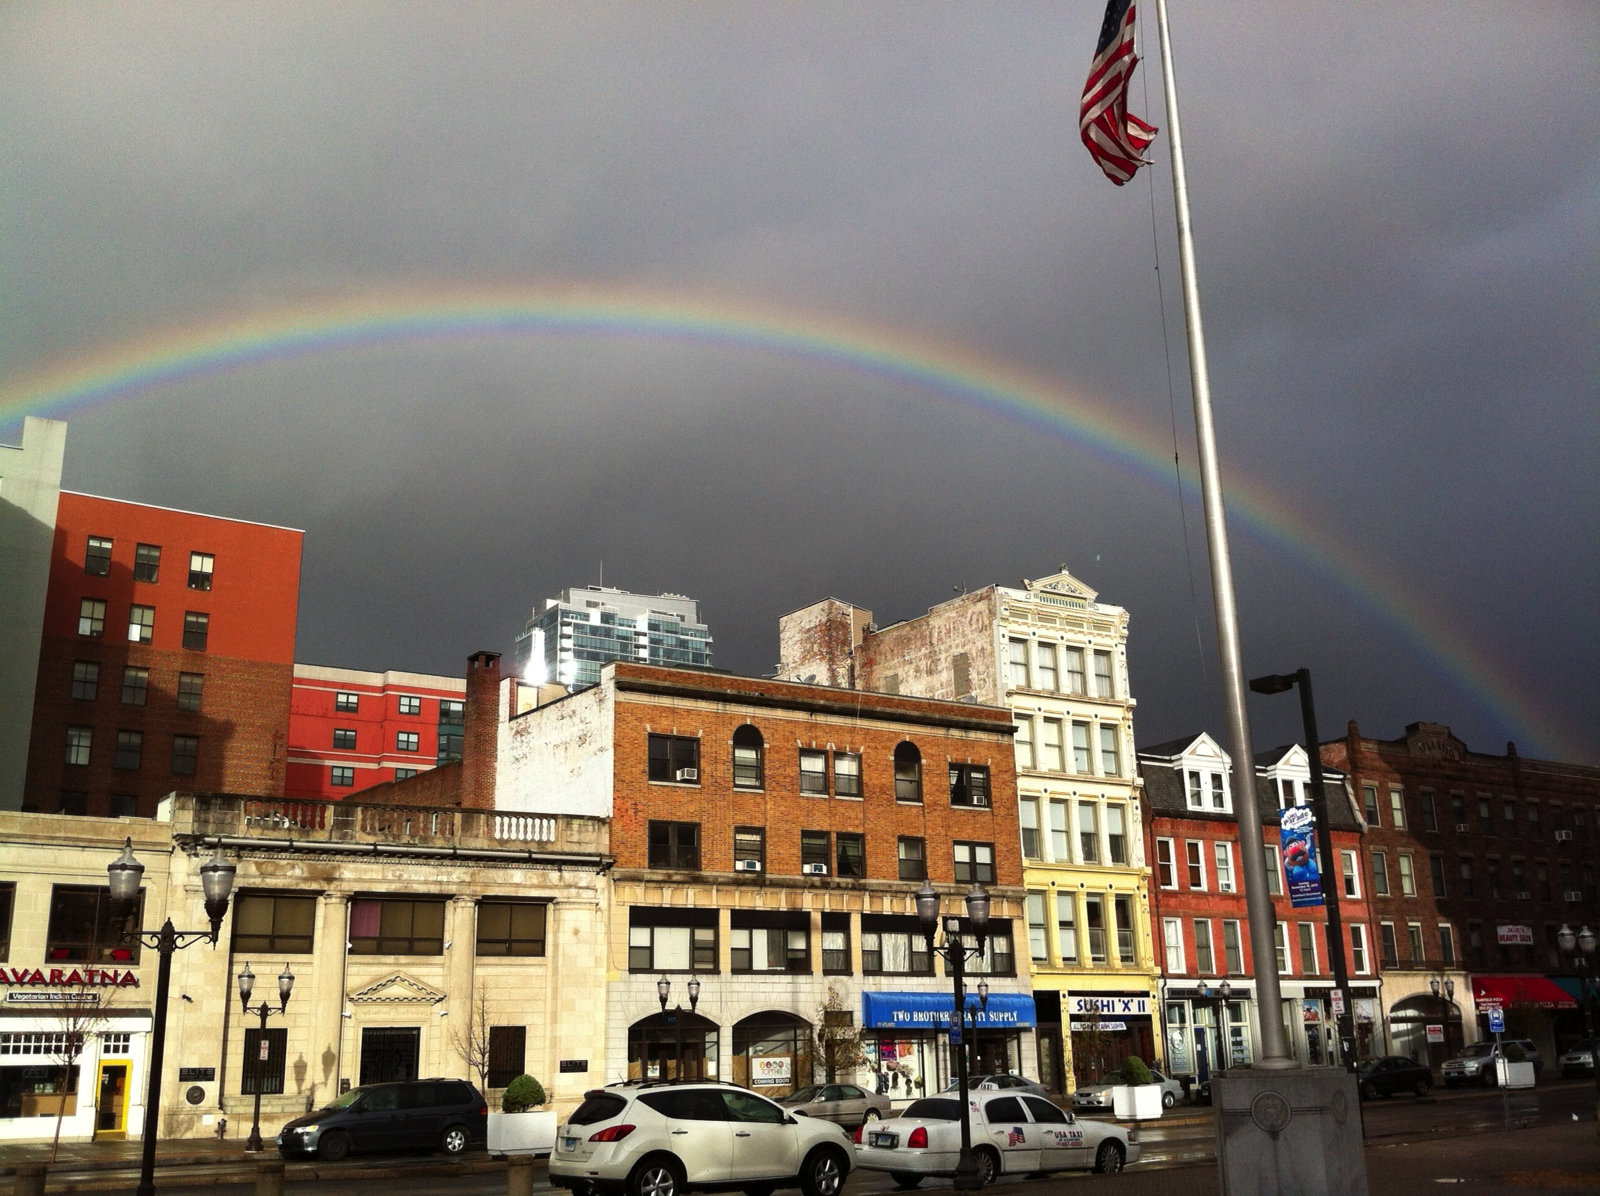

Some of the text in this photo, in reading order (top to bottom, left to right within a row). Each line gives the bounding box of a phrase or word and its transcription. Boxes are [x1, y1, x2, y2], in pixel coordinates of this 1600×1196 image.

[12, 993, 48, 1001] Vegetarian
[1077, 998, 1115, 1012] SUSHI
[892, 1010, 911, 1021] TWO
[913, 1010, 952, 1022] BROTHER
[989, 1010, 1018, 1022] SUPPLY
